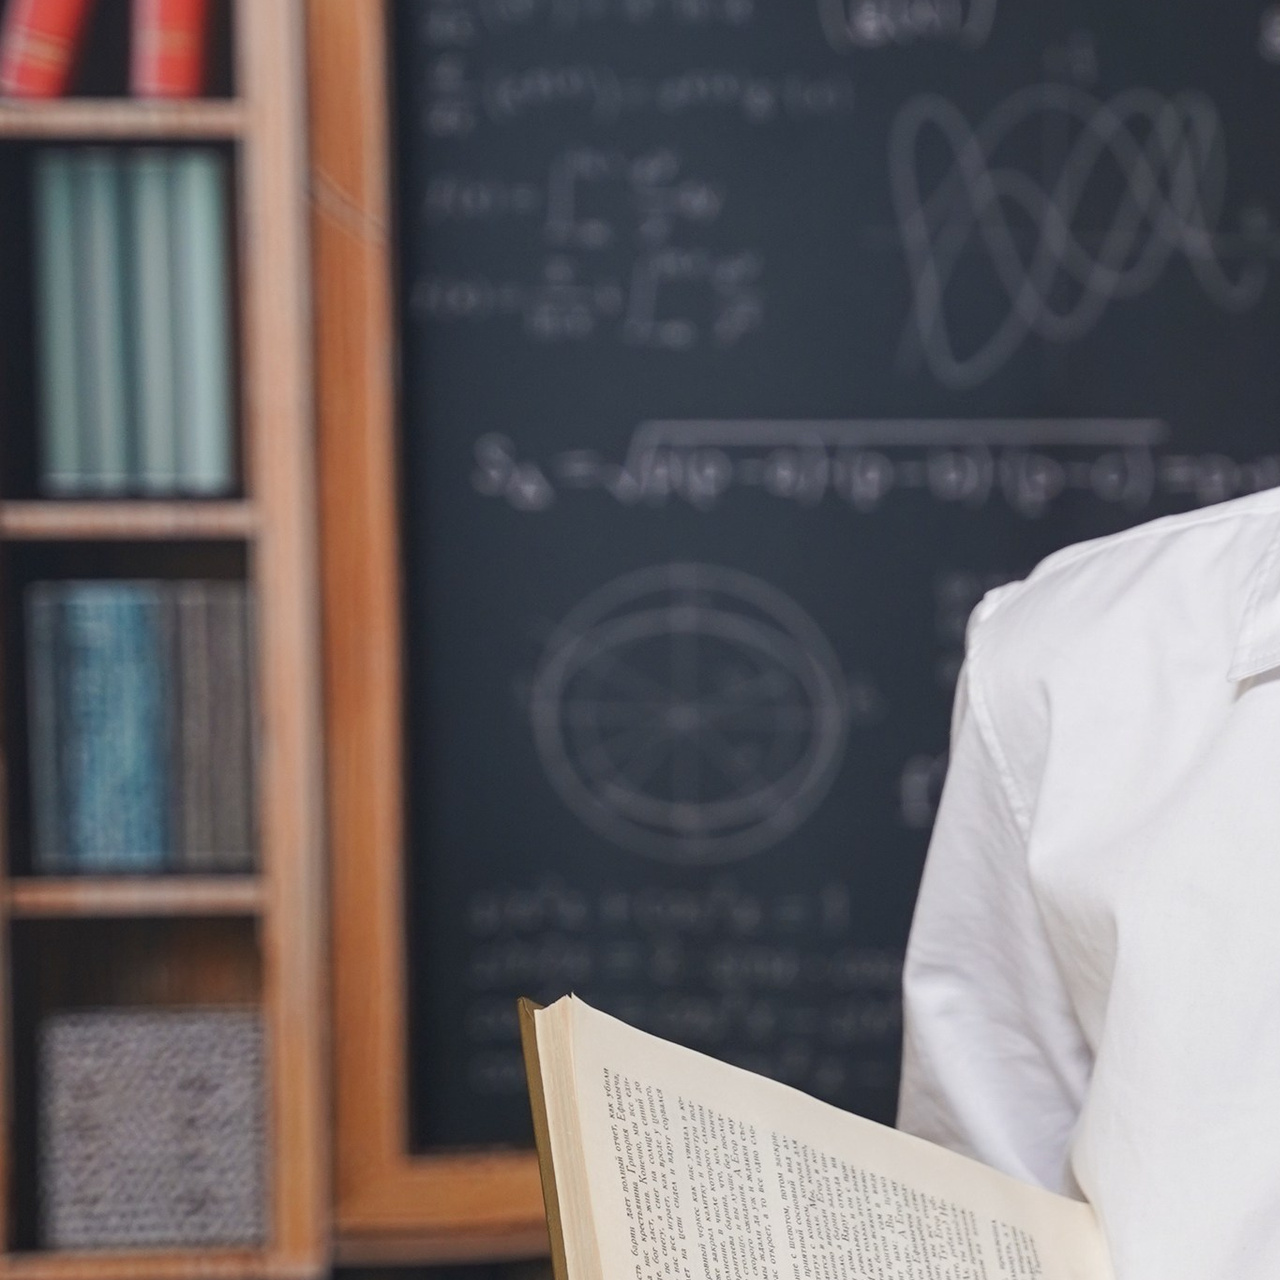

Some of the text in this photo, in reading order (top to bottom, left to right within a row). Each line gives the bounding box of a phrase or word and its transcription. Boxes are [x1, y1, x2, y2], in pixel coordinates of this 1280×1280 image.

[602, 1067, 614, 1099] убили
[613, 1073, 627, 1122] Ефимыча,
[623, 1076, 632, 1098] еди-
[607, 1102, 615, 1119] как
[627, 1101, 636, 1118] все
[645, 1085, 660, 1125] цепного,
[655, 1087, 670, 1131] сорвался
[677, 1096, 685, 1111] ко-
[610, 1123, 622, 1152] отчет,
[621, 1127, 640, 1177] Григория
[643, 1130, 655, 1165] солнце
[664, 1134, 674, 1164] вдруг
[691, 1125, 703, 1167] изнутри
[635, 1140, 648, 1185] Конечно,
[655, 1139, 666, 1168] вроде
[614, 1155, 629, 1193] полный
[660, 1172, 668, 1190] как
[686, 1163, 695, 1181] нас
[623, 1196, 634, 1220] дает
[652, 1187, 661, 1210] снег
[671, 1181, 680, 1209] сидел
[690, 1185, 698, 1203] как
[632, 1181, 648, 1243] крестьянина
[663, 1195, 674, 1231] играет,
[693, 1206, 705, 1239] черкес
[629, 1225, 639, 1257] барин
[647, 1218, 657, 1244] даст,
[658, 1227, 668, 1257] снегу,
[675, 1215, 686, 1240] цепи
[651, 1245, 660, 1265] бог
[668, 1234, 677, 1252] все
[642, 1249, 651, 1268] нас
[671, 1256, 680, 1274] нас
